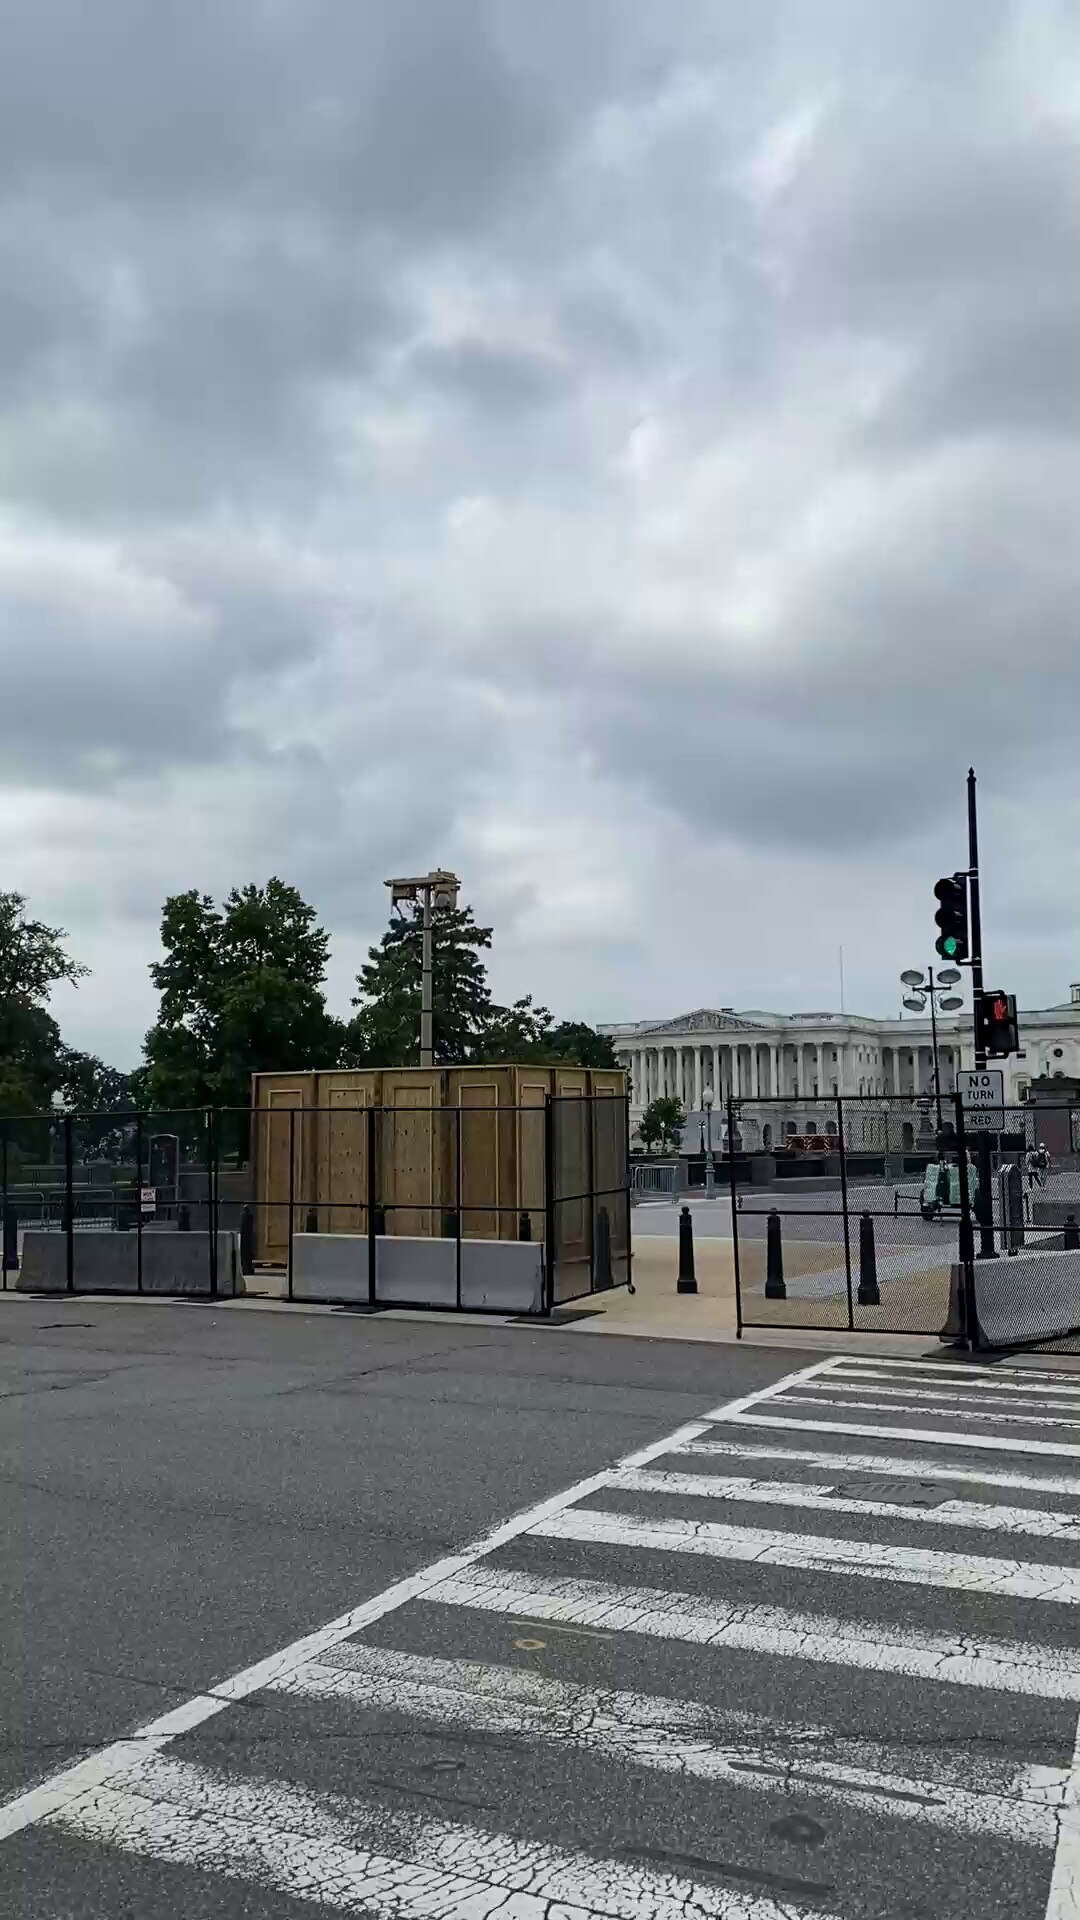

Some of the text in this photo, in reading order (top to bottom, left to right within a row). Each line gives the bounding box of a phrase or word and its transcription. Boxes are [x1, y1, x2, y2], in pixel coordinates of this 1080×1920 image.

[969, 1076, 990, 1087] NO
[967, 1090, 994, 1100] TURN
[971, 1115, 992, 1125] RED
